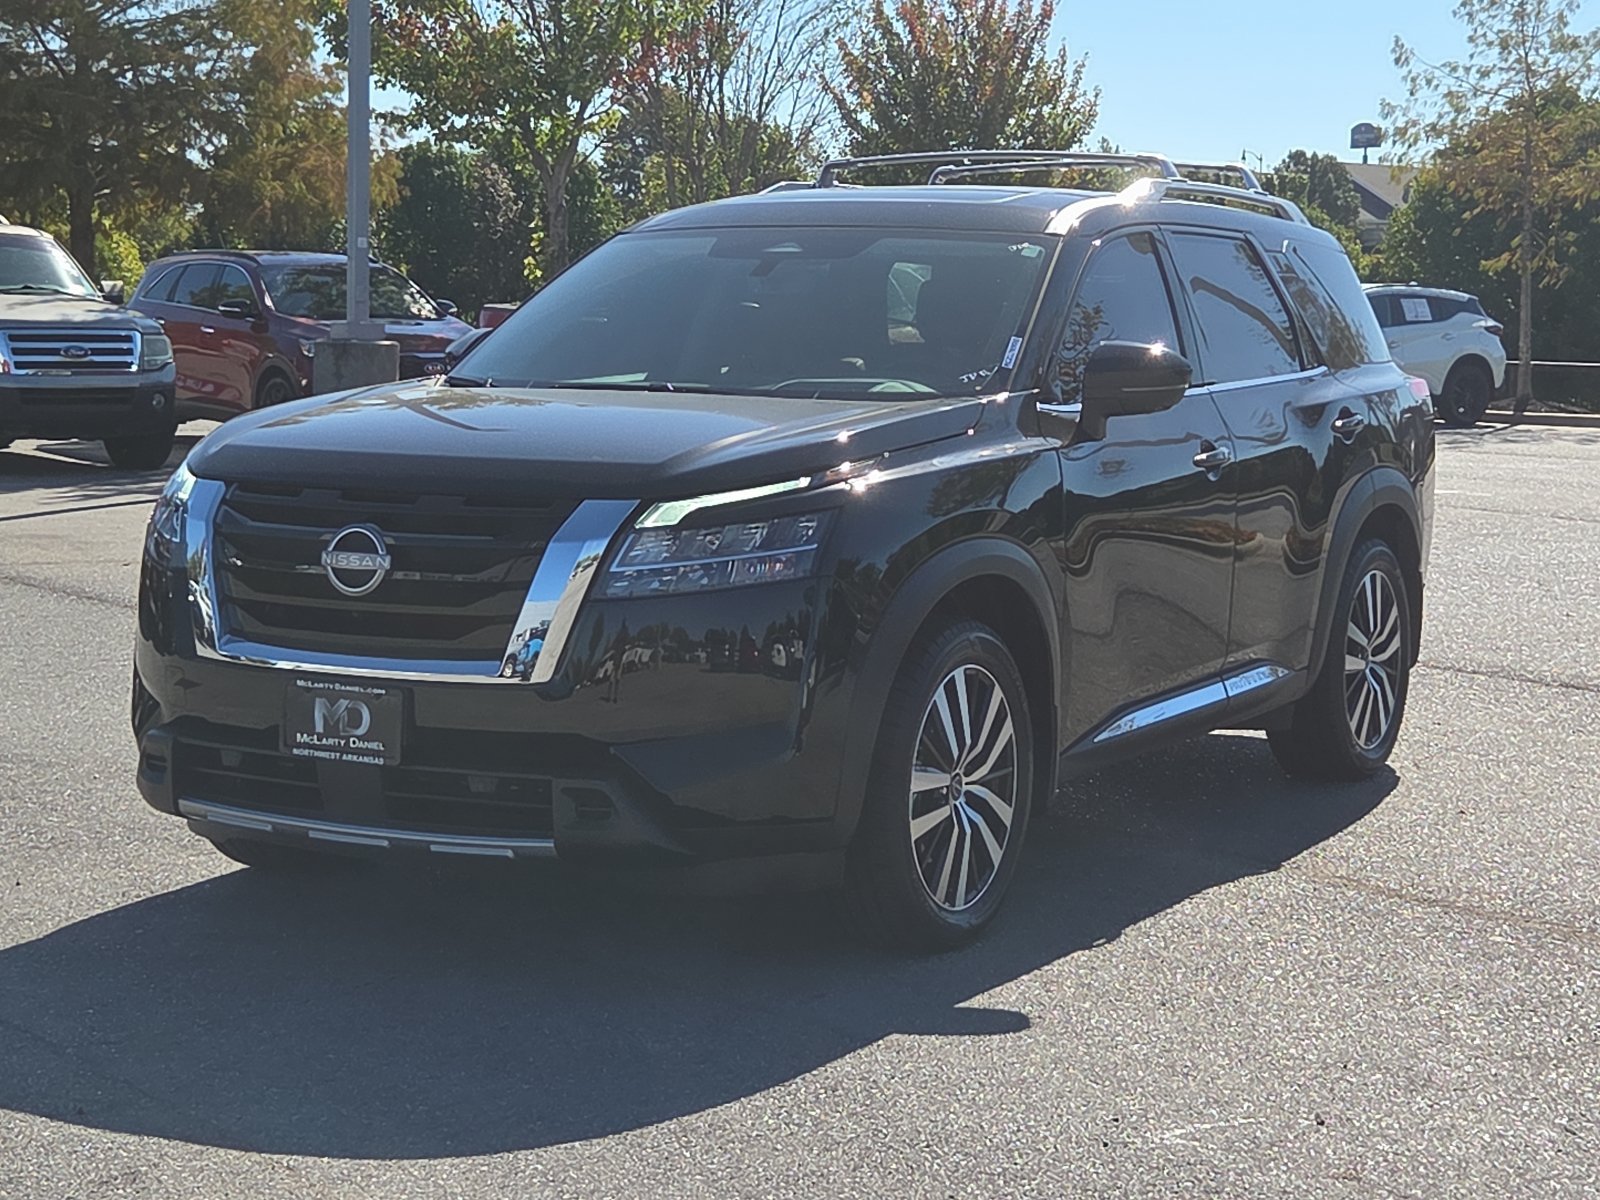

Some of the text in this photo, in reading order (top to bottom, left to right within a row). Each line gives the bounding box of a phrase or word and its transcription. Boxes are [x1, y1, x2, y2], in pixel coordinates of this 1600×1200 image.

[321, 551, 391, 569] NISSAN
[314, 697, 371, 736] MD
[292, 748, 384, 765] NORTHWEST ARKANSAS
